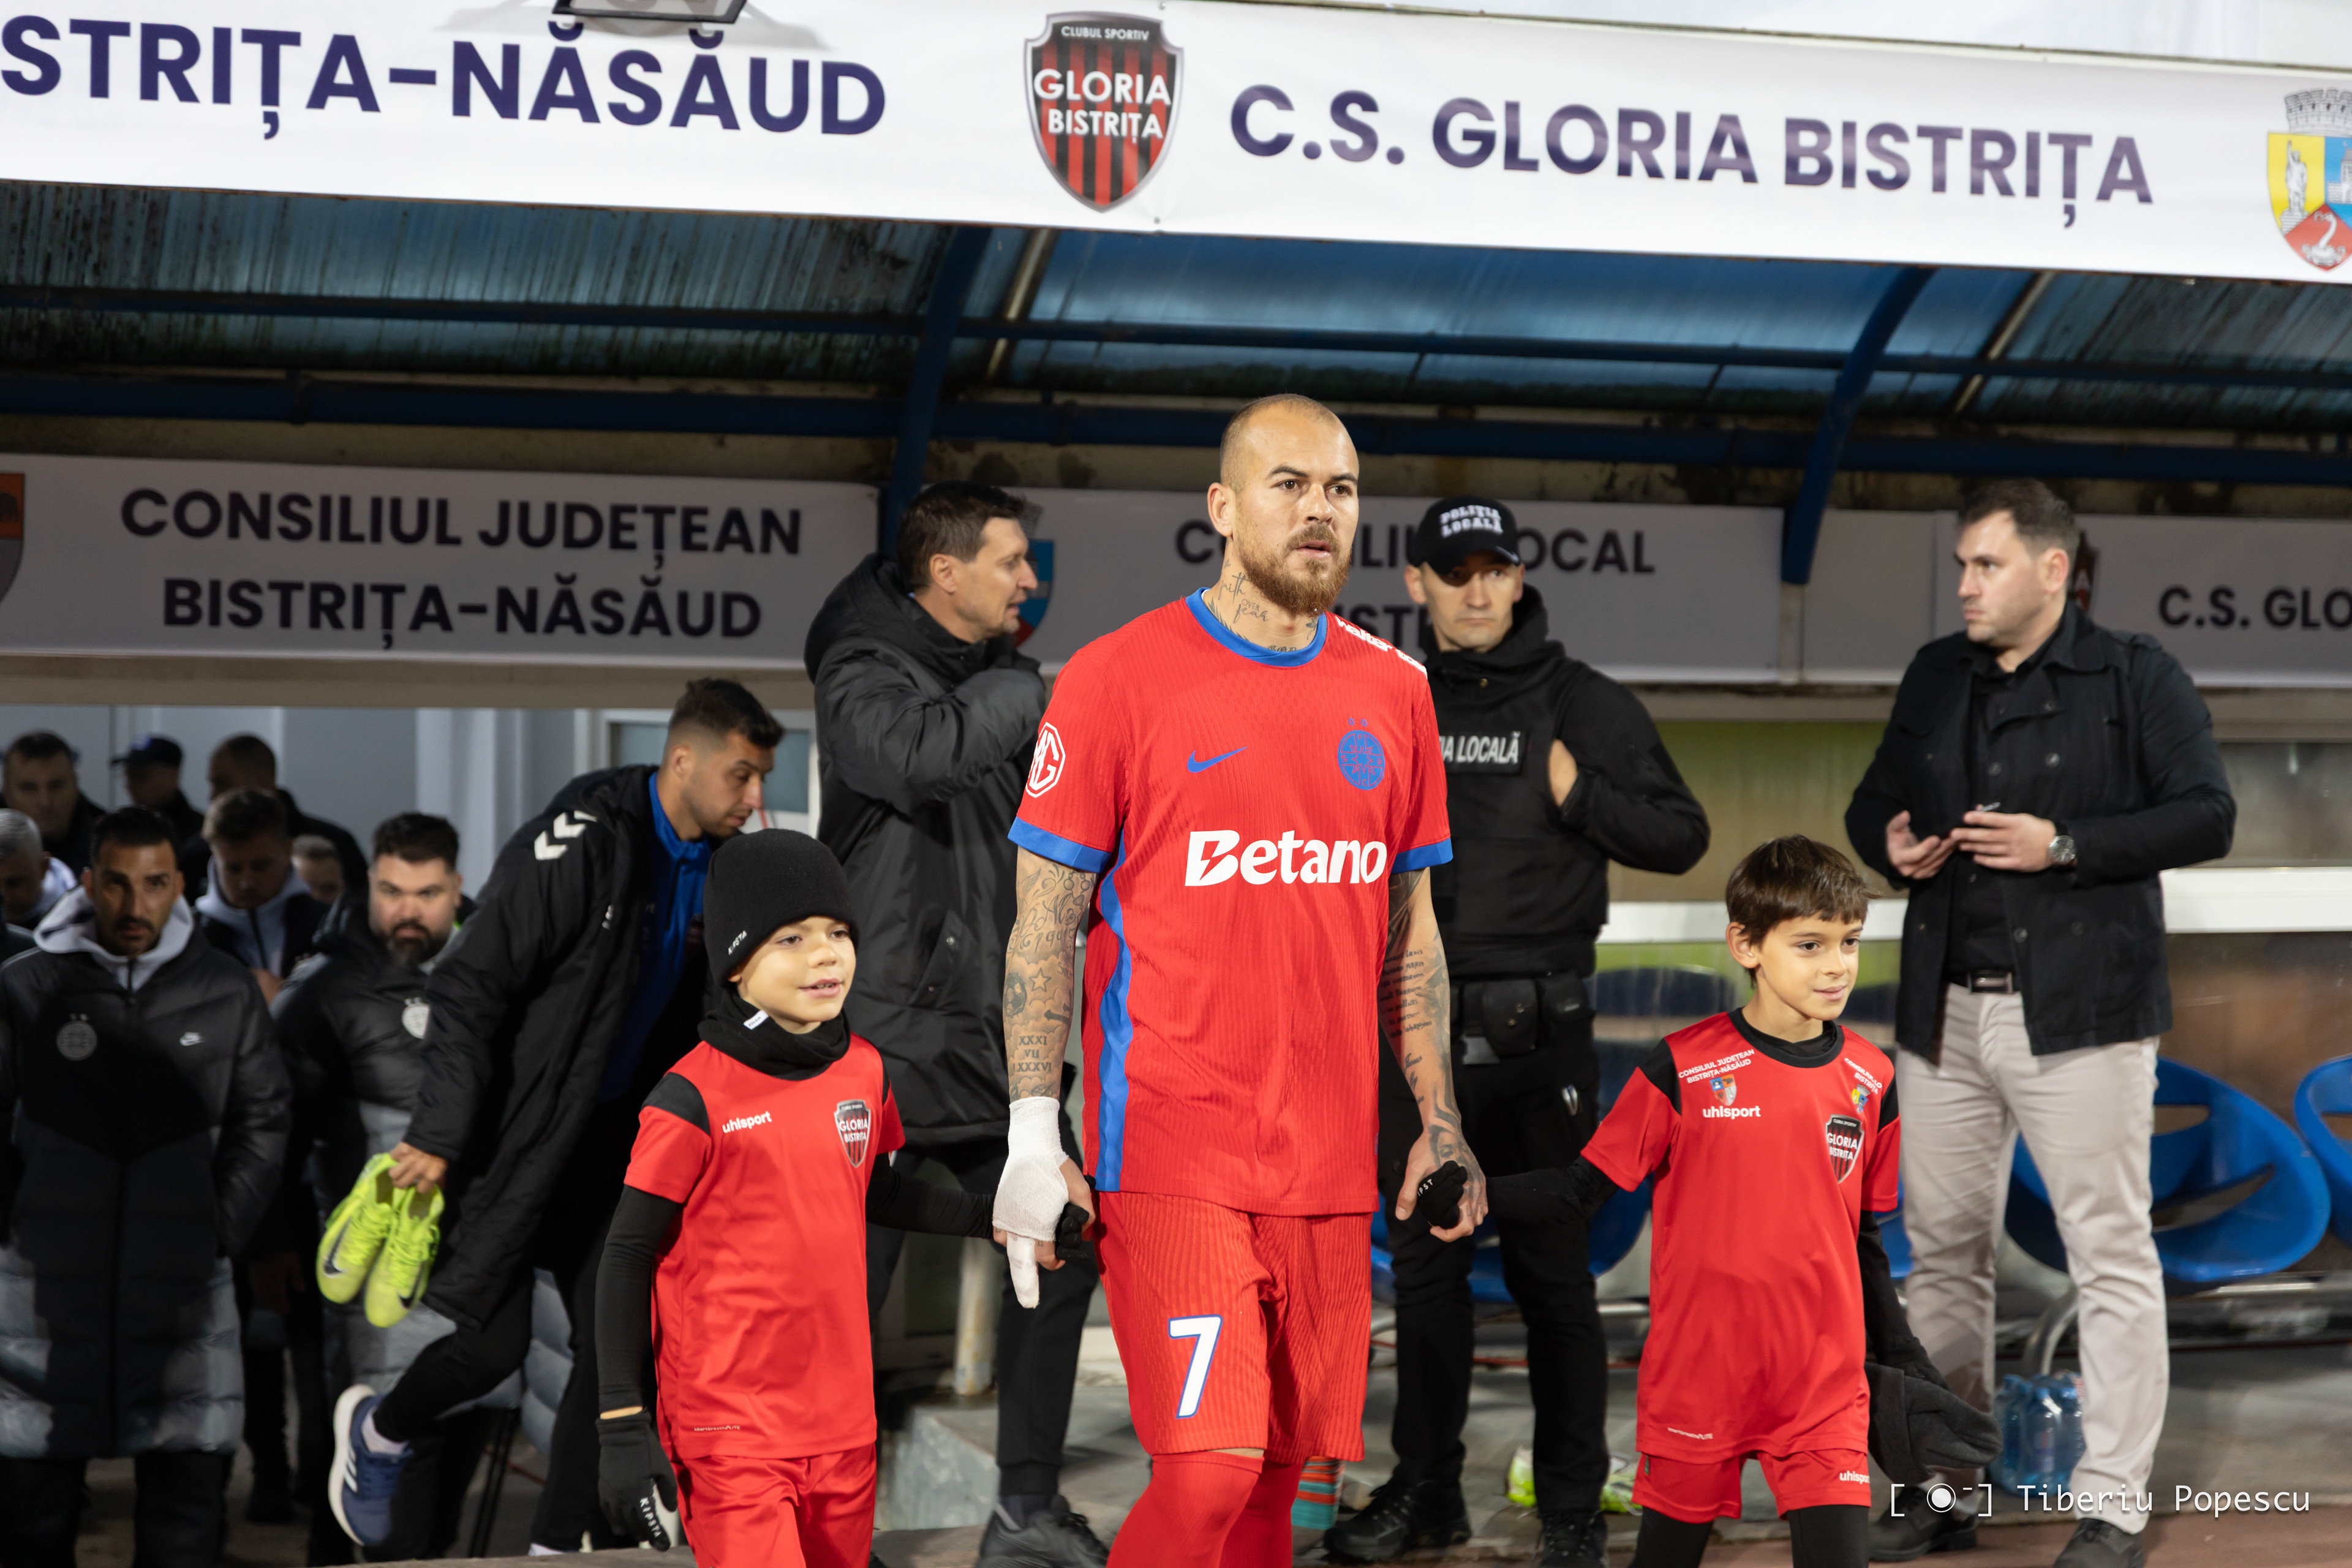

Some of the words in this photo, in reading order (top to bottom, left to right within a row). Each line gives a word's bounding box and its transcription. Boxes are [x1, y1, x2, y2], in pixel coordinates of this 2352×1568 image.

[1061, 26, 1102, 39] CLUBUL
[1104, 28, 1150, 41] SPORTIV
[1033, 68, 1172, 105] GLORIA
[1047, 108, 1164, 145] BISTRIȚA
[1231, 83, 1406, 165] C.S.
[1432, 96, 1760, 184] GLORIA
[1784, 116, 2153, 228] BISTRIȚA
[121, 488, 462, 546] CONSILIUL
[478, 499, 802, 569] JUDEȚEAN
[1517, 529, 1655, 574] OCAL
[1234, 604, 1270, 624] fear
[1242, 598, 1261, 610] OVER
[2158, 584, 2251, 629] C.S.
[1456, 731, 1520, 764] LOCALĂ
[1185, 830, 1387, 887] Betano
[1019, 1035, 1047, 1046] XXXI
[1678, 1061, 1717, 1078] CONSILIUL
[1717, 1049, 1755, 1066] JUDEȚEAN
[722, 1110, 772, 1133] uhlsport
[839, 1118, 868, 1132] GLORIA
[1702, 1106, 1762, 1120] uhlsport
[1827, 1133, 1858, 1149] GLORIA
[1417, 1178, 1433, 1196] IPST
[1167, 1314, 1223, 1419] 7
